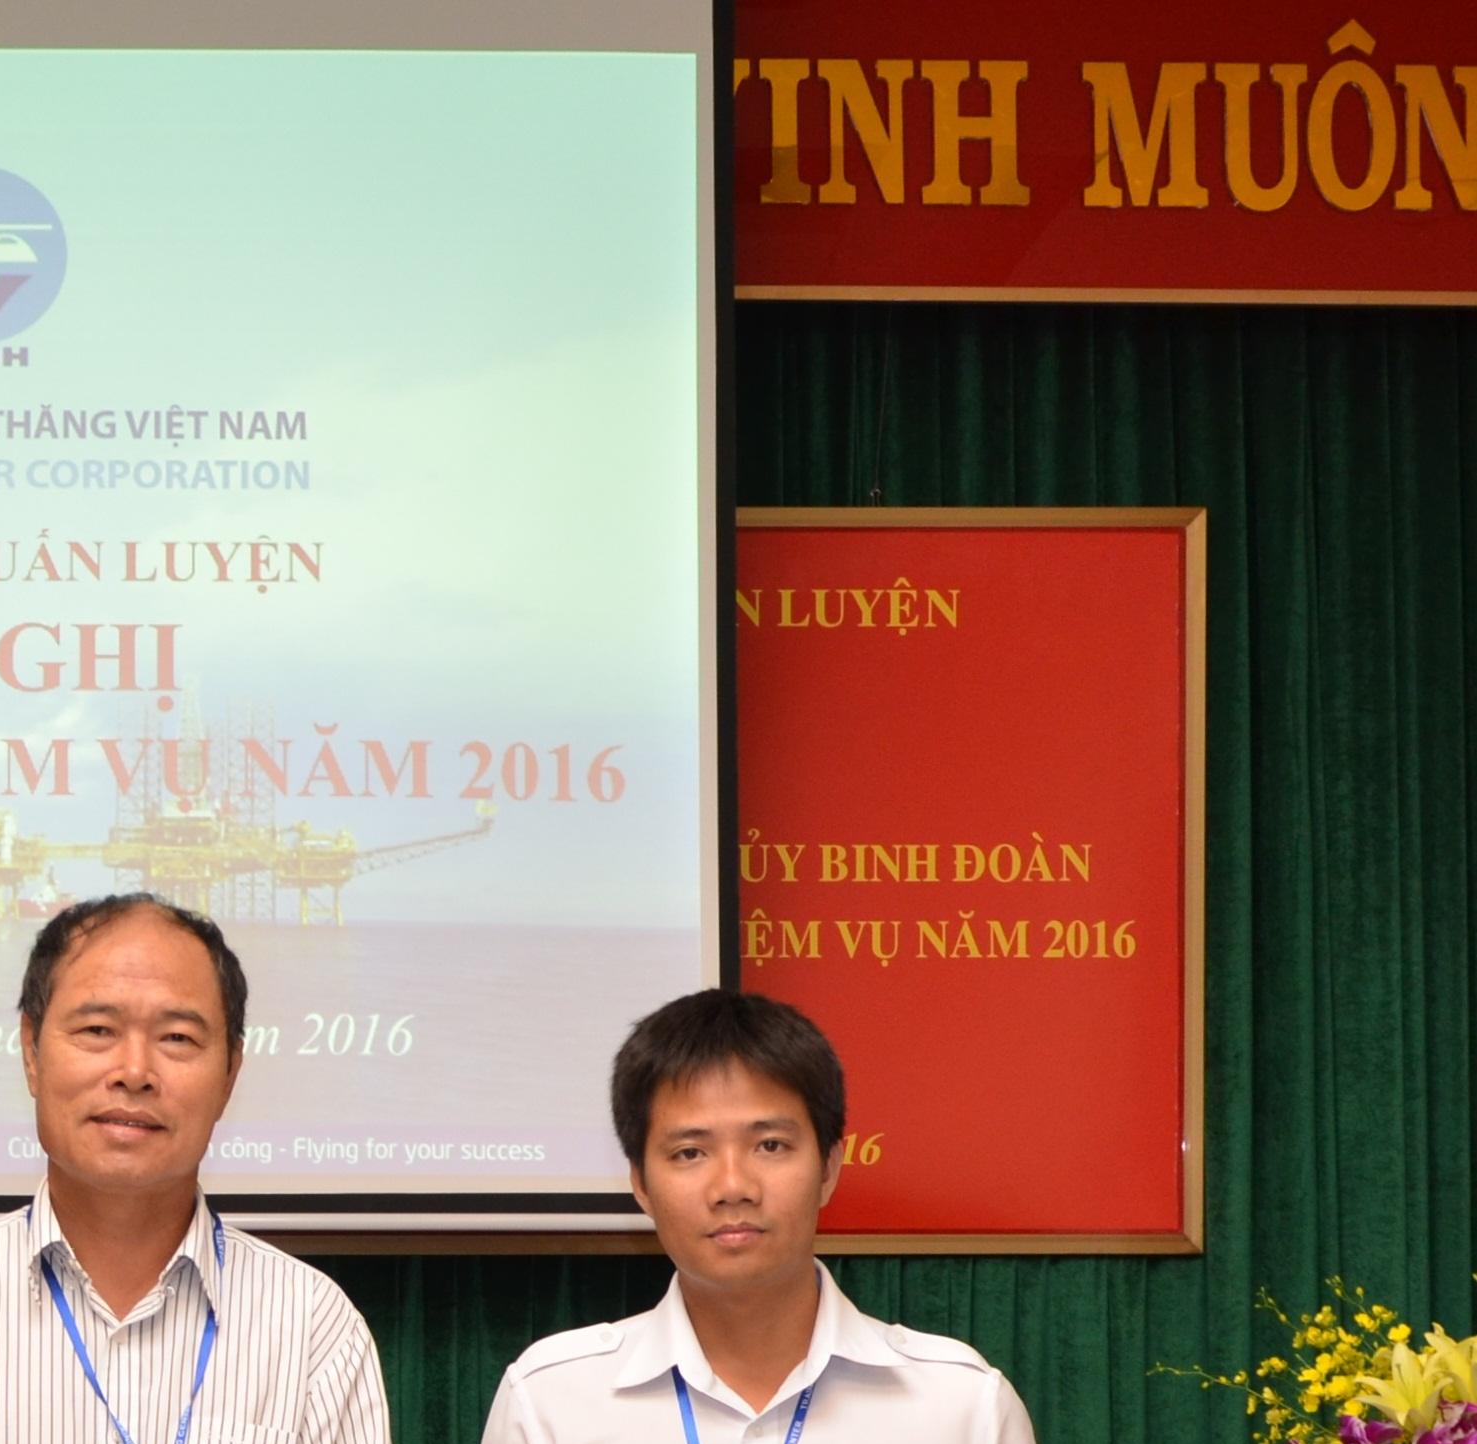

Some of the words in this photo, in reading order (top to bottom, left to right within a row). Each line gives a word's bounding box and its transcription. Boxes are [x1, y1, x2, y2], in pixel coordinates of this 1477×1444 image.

[734, 58, 1031, 206] INH
[125, 404, 209, 447] VIỆT
[219, 411, 308, 440] NAM
[25, 459, 311, 490] CORPORATION
[121, 535, 325, 595] LUYỆN
[777, 576, 961, 636] LUYỆN
[95, 738, 212, 814] VỤ
[238, 721, 435, 799] NĂM
[457, 740, 626, 803] 2016
[818, 843, 940, 883] BINH
[952, 832, 1092, 883] ĐOÀN
[740, 908, 822, 967] ỆM
[835, 920, 902, 967] VỤ
[916, 910, 1031, 959] NĂM
[1042, 919, 1137, 959] 2016
[297, 1013, 415, 1056] 2016
[220, 1136, 272, 1164] công
[293, 1137, 358, 1164] Flying
[366, 1136, 397, 1160] for
[404, 1143, 455, 1165] your
[461, 1143, 546, 1161] success
